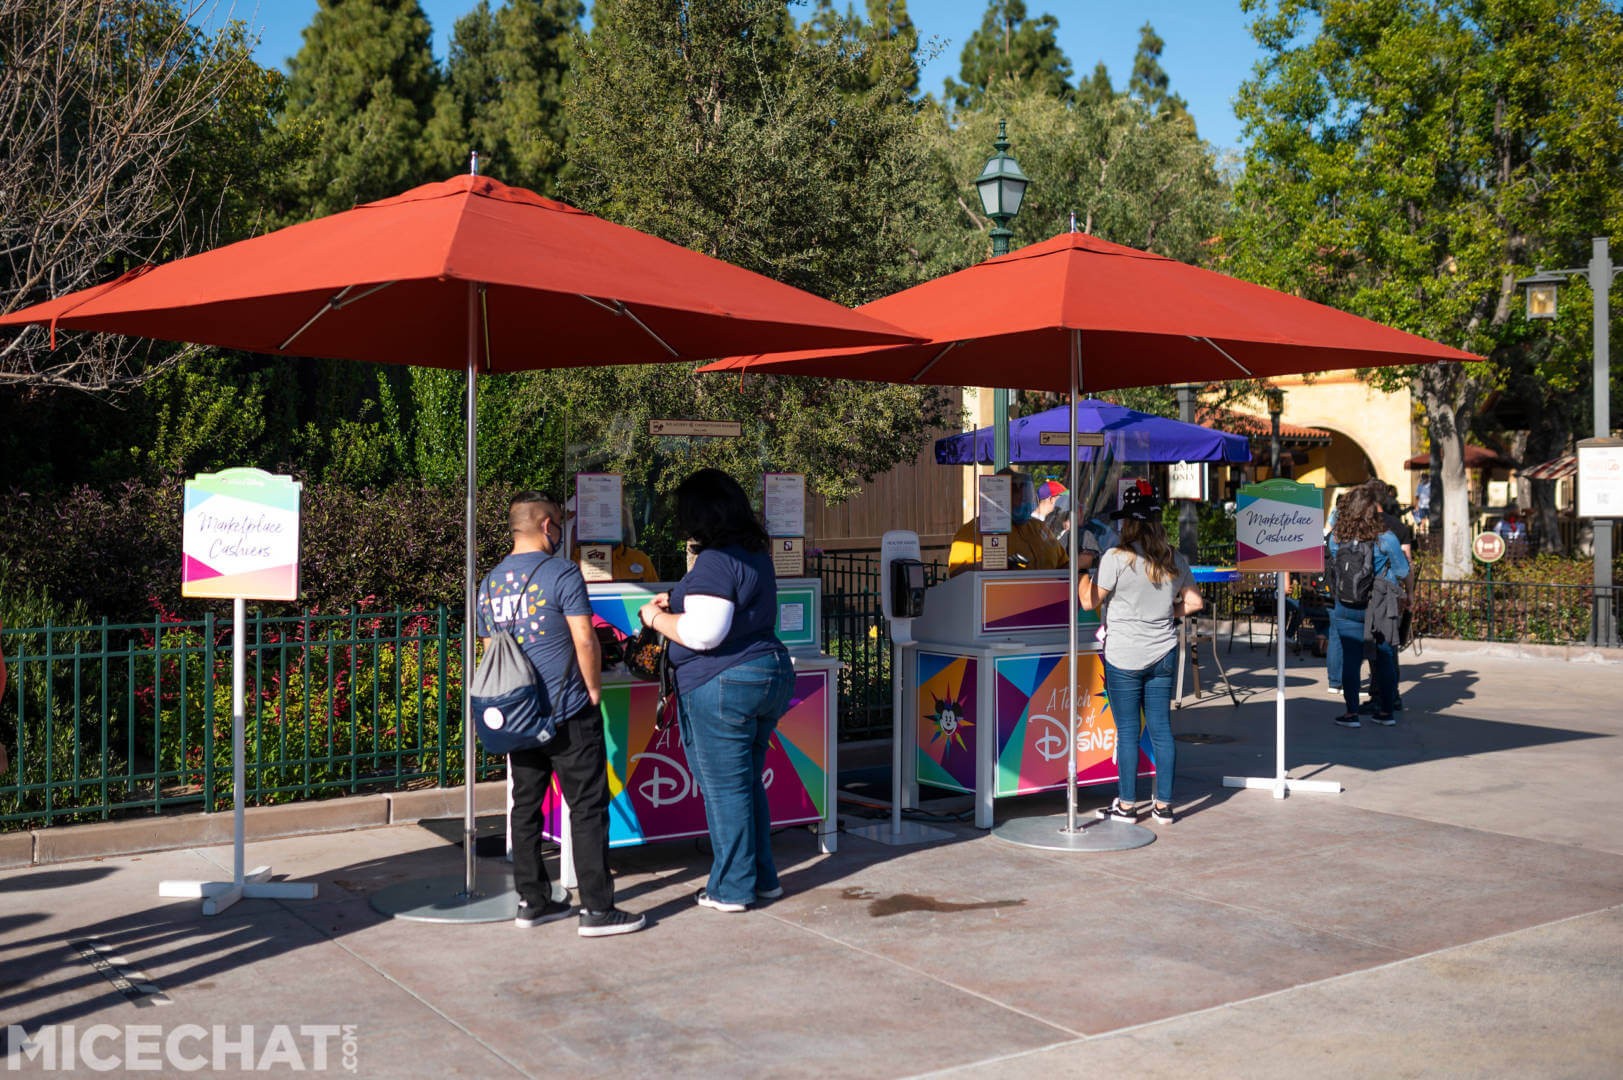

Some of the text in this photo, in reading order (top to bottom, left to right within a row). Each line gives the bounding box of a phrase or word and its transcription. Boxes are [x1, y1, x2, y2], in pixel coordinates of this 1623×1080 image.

[198, 512, 283, 539] Marketplace
[1246, 511, 1314, 529] Marketplace
[1256, 528, 1304, 545] Cashiers
[209, 537, 271, 560] Cashiers
[1046, 686, 1091, 713] A Toch
